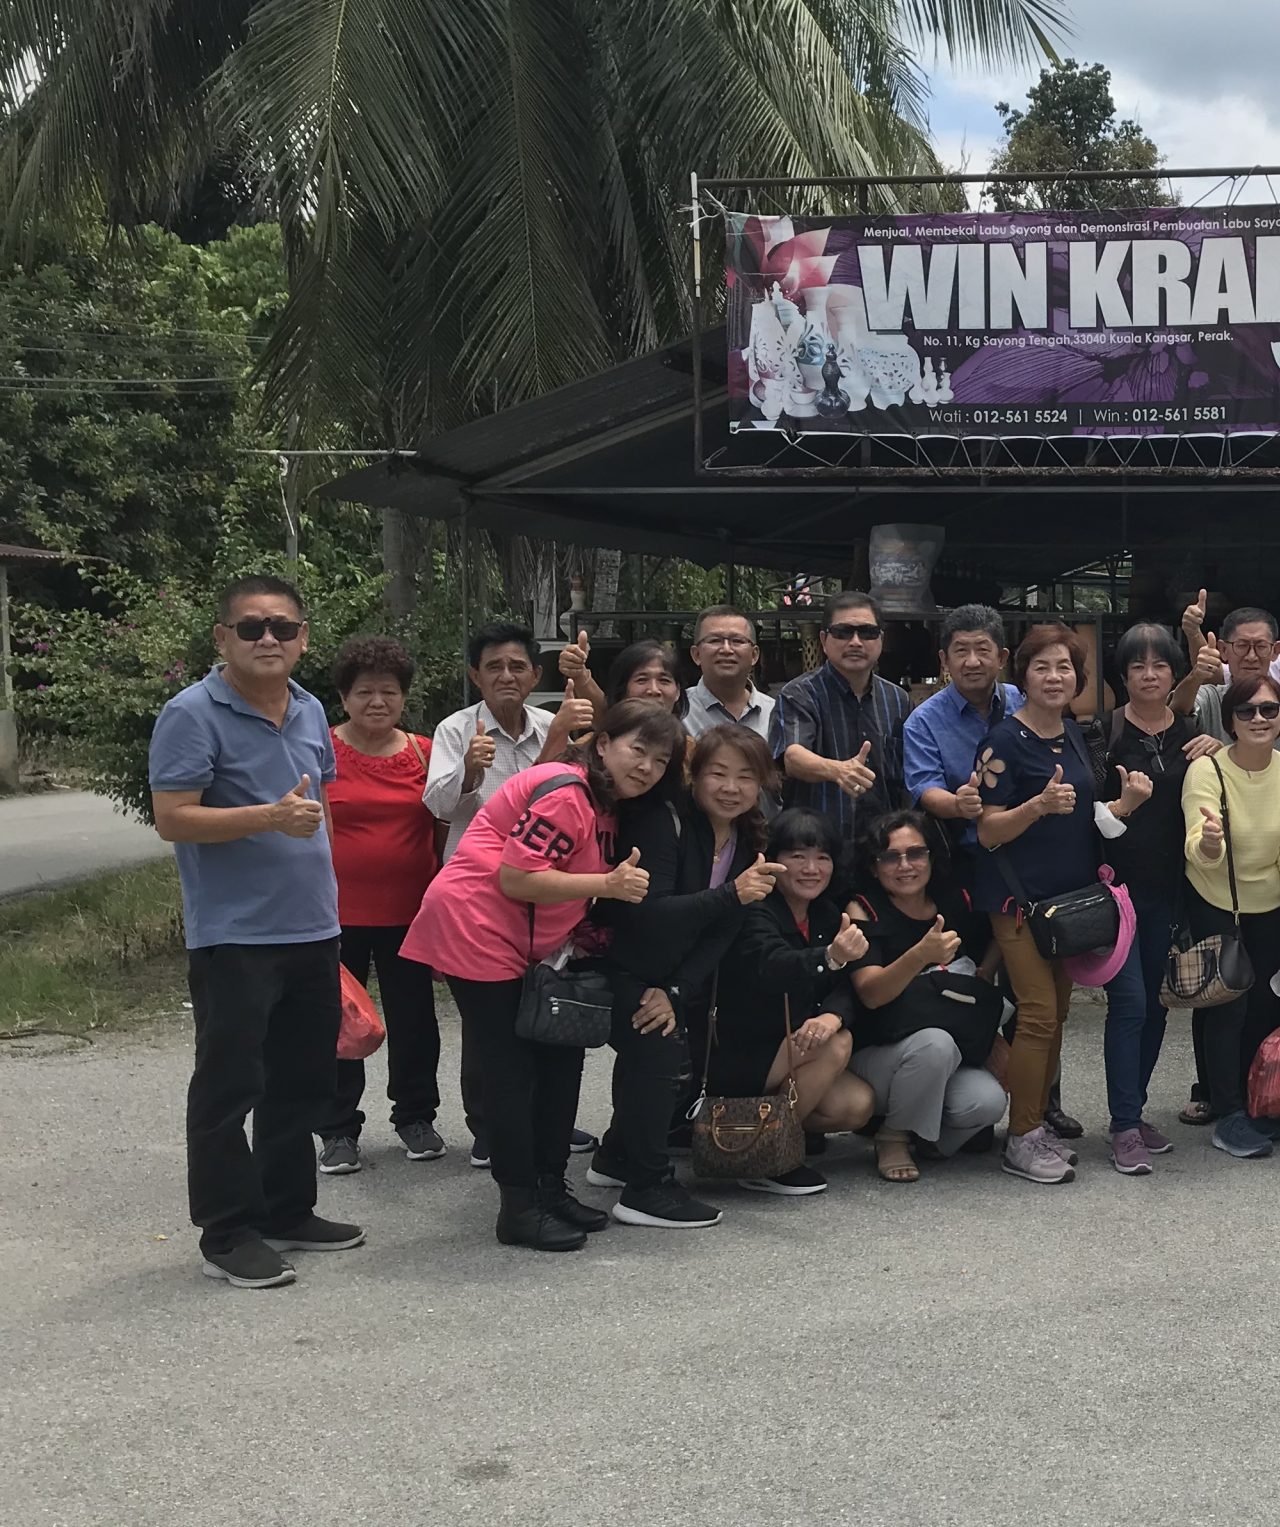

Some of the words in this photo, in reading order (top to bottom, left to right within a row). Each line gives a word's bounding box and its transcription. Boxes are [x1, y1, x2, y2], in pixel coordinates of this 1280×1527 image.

[864, 225, 912, 240] Menjual,
[915, 224, 976, 237] Membekal
[979, 223, 1006, 236] Labu
[1009, 223, 1050, 239] Sayong
[1054, 222, 1078, 235] dan
[1080, 220, 1150, 234] Demonstrasi
[1153, 219, 1220, 232] Pembuatan
[1223, 218, 1251, 229] Labu
[857, 242, 1048, 331] WIN
[923, 335, 943, 346] No.
[946, 335, 962, 347] 11,
[965, 335, 980, 348] Kg
[983, 335, 1026, 348] Sayong
[1109, 333, 1142, 344] Kuala
[1145, 332, 1194, 346] Kangsar,
[1198, 331, 1234, 342] Perak.
[929, 409, 962, 423] Wati
[973, 410, 1029, 423] 012-561
[1034, 409, 1068, 423] 5524
[1093, 408, 1120, 422] Win
[1132, 407, 1188, 421] 012-561
[1193, 406, 1226, 421] 5581
